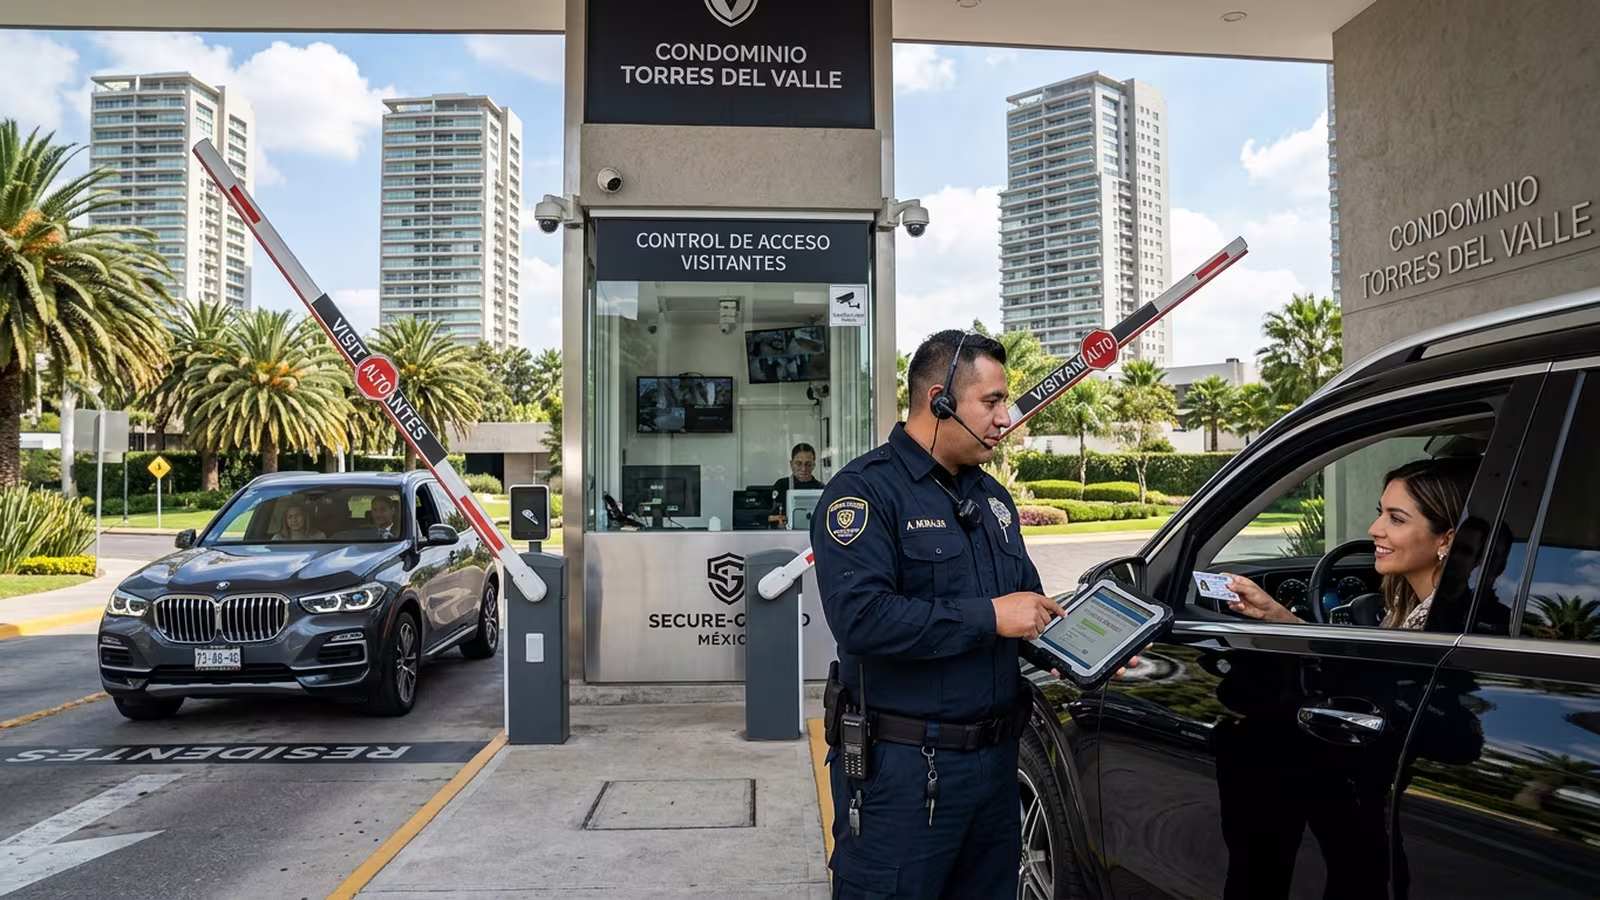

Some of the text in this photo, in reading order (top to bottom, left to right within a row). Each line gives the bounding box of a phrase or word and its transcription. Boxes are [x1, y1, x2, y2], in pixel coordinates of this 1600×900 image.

[655, 42, 807, 64] CONDOMINIO
[620, 65, 843, 89] TORRES DEL VALLE
[1389, 175, 1539, 252] CONDOMINIO
[636, 232, 831, 251] CONTROL DE ACCESO
[1359, 200, 1593, 299] TORRES DEL VALLE
[681, 254, 787, 271] VISITANTES
[1086, 337, 1114, 363] ALTO
[362, 363, 392, 395] ALTO
[698, 632, 746, 646] MÉXIC
[5, 744, 412, 763] RESIDENTES
